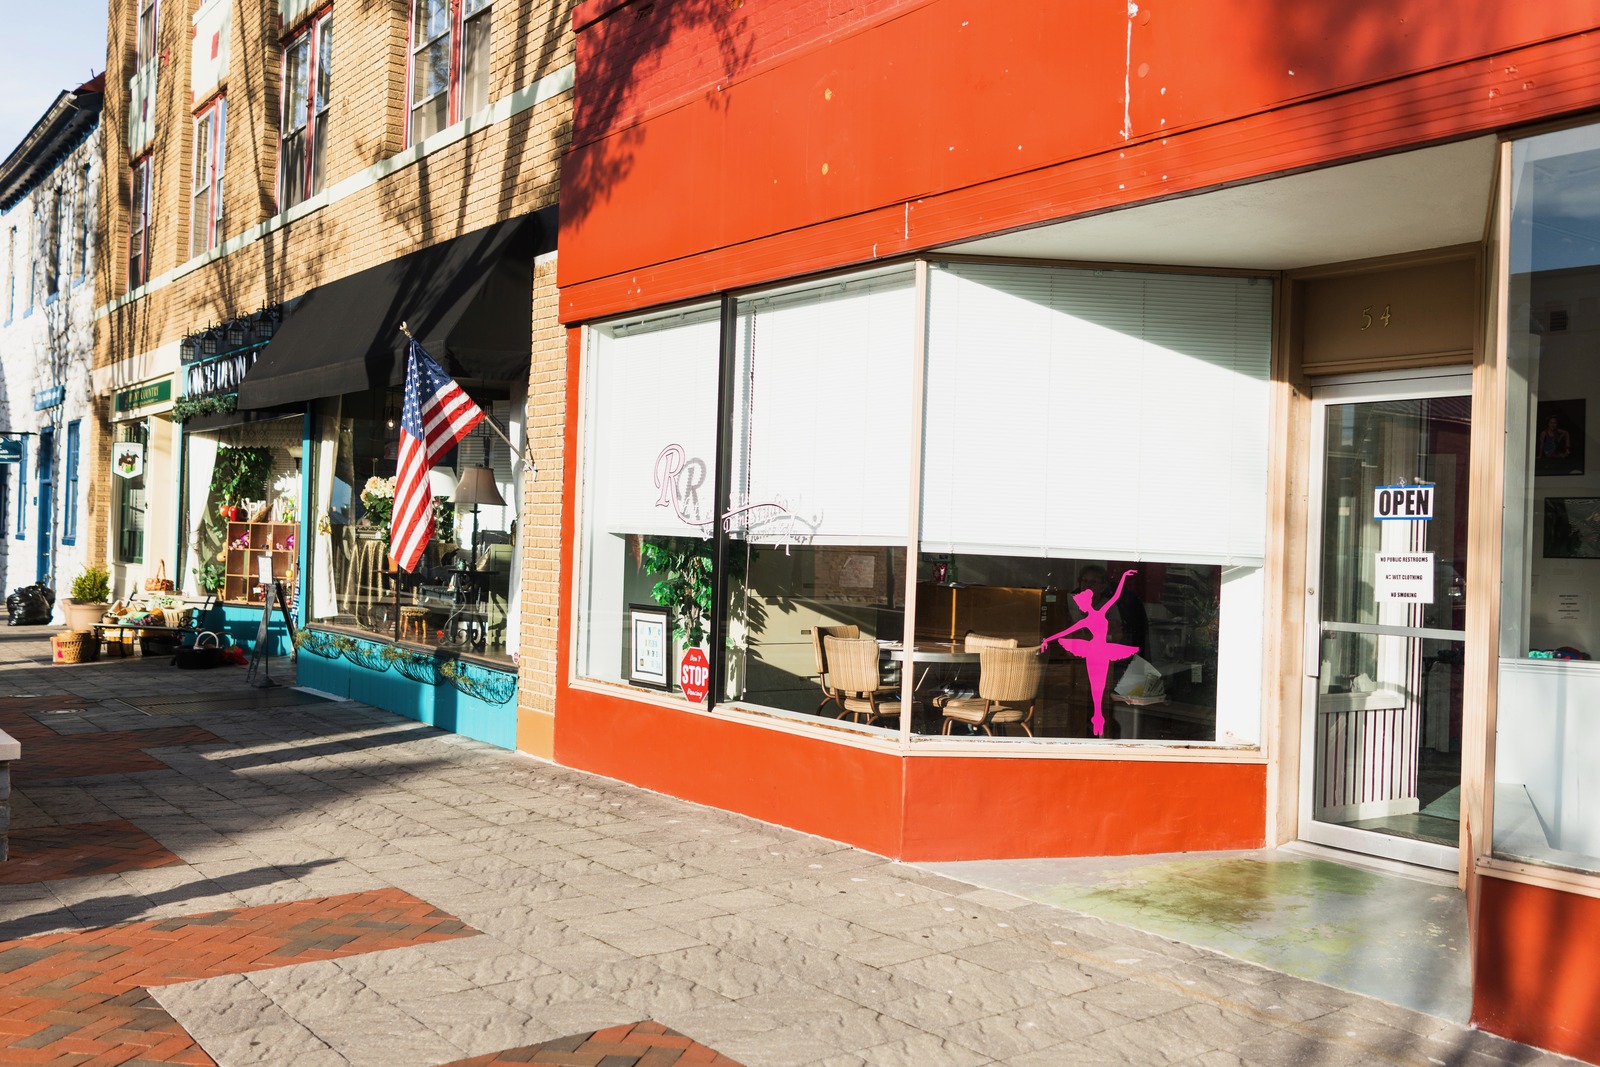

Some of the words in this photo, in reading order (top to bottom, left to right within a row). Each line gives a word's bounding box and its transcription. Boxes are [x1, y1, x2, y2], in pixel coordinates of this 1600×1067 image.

[1361, 304, 1392, 331] 54
[1378, 490, 1429, 516] OPEN
[682, 664, 709, 687] STOP
[687, 688, 703, 699] Dancing
